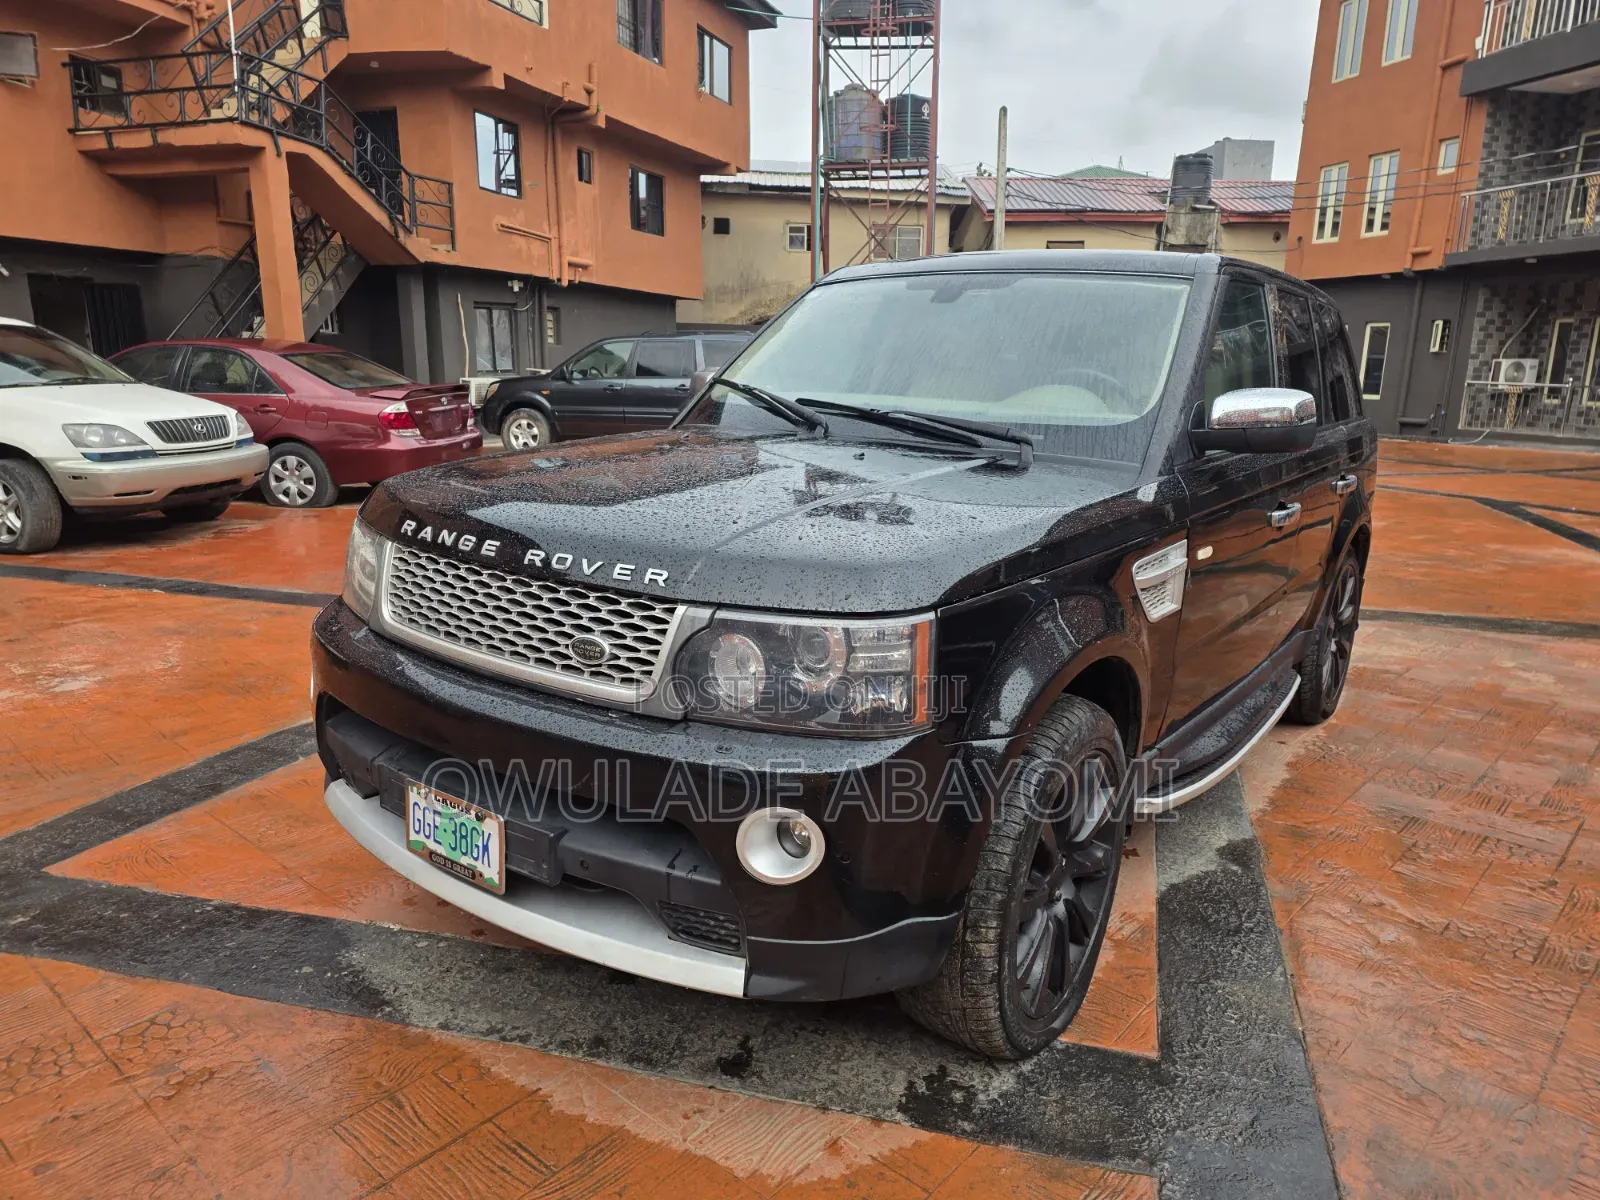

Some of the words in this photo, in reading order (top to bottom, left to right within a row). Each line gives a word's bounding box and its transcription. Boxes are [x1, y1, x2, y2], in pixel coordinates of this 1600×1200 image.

[400, 519, 501, 557] RANGE
[523, 549, 670, 587] ROVER
[573, 647, 601, 658] ROVER
[574, 642, 602, 652] RANGE
[431, 853, 445, 865] GOD
[452, 863, 474, 878] GREAT
